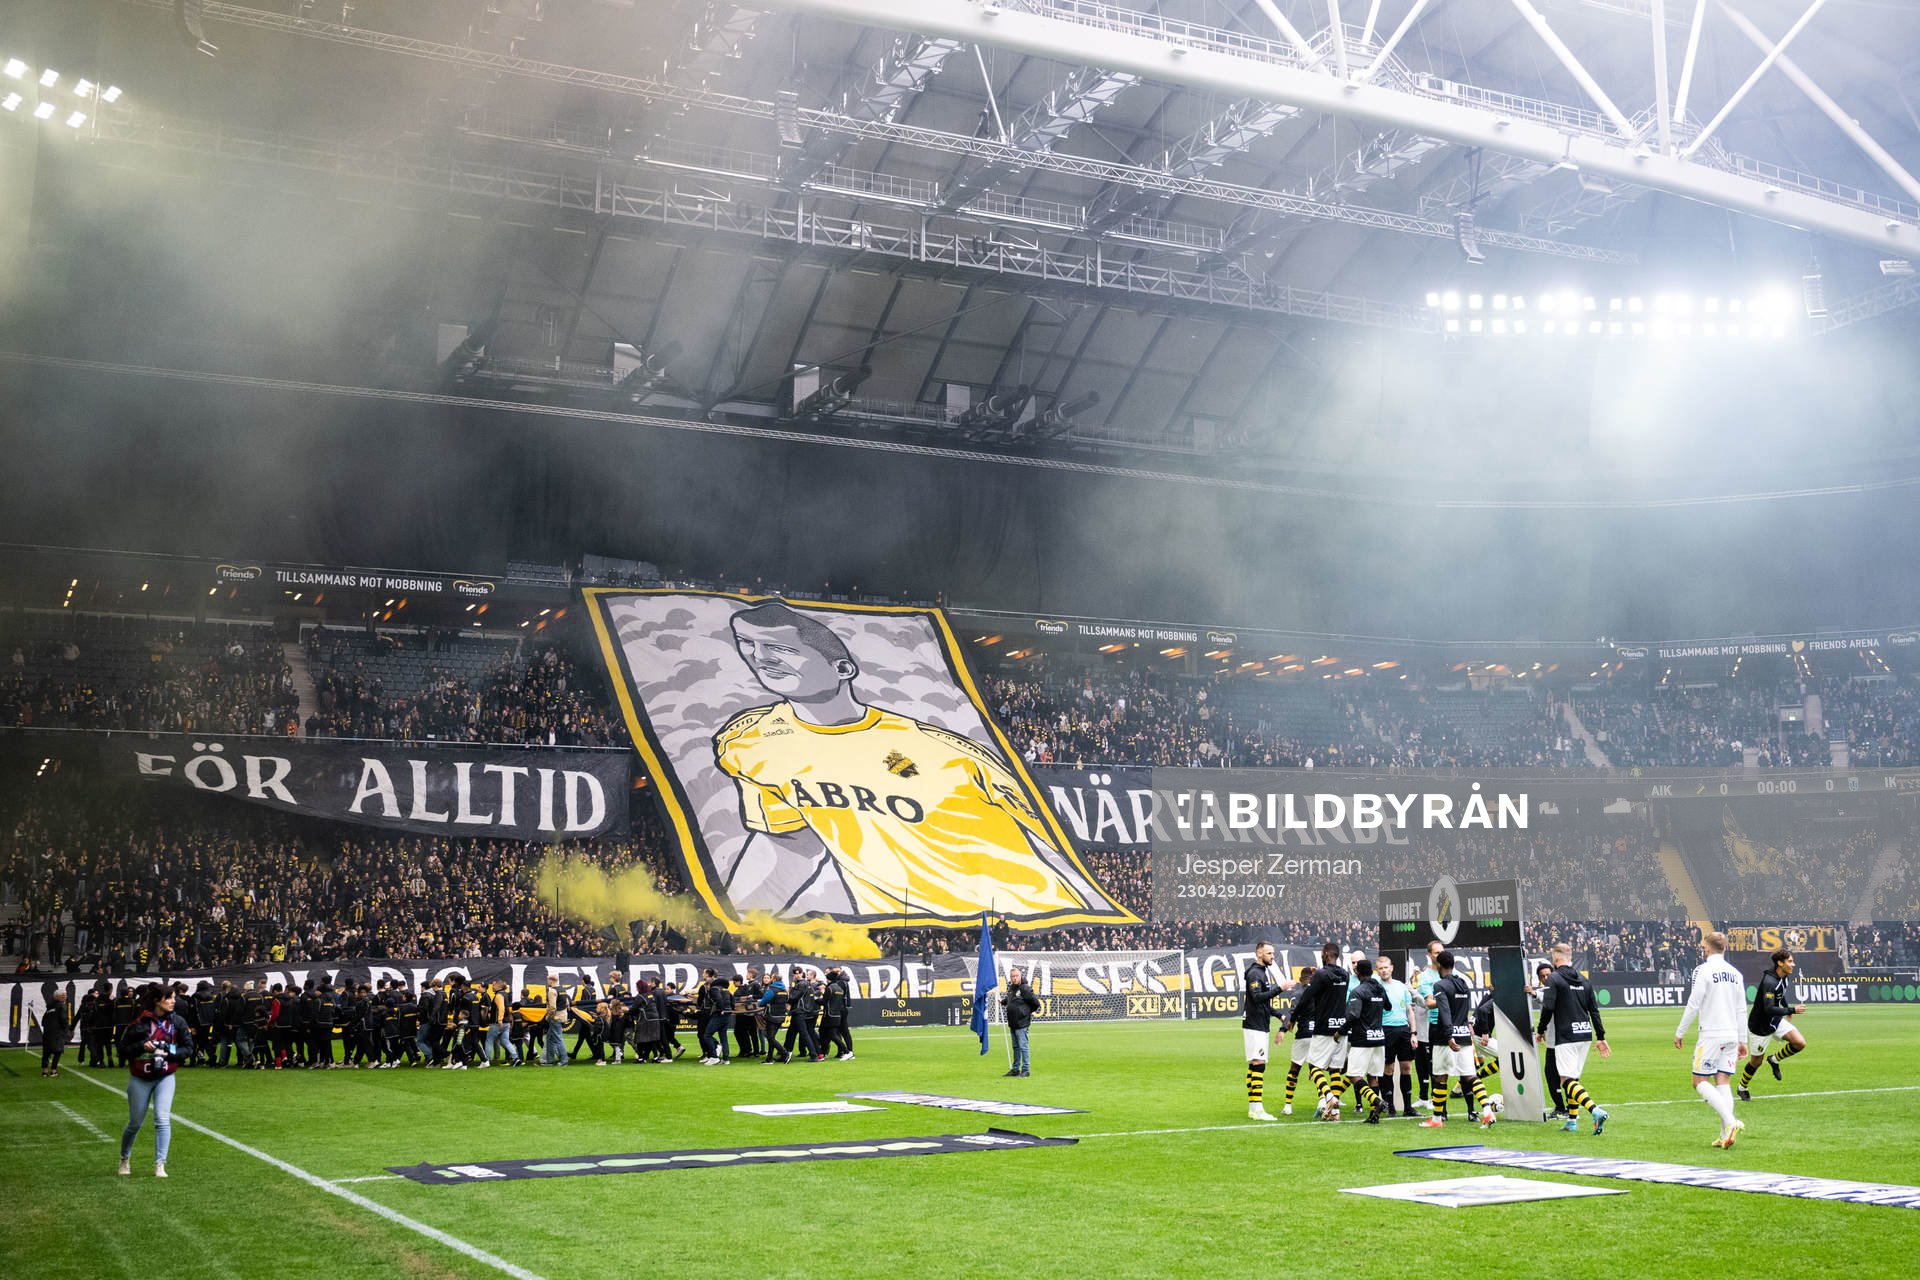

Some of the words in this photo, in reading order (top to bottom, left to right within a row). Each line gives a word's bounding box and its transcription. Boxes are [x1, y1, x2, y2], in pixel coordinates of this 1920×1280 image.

[222, 569, 254, 579] friends
[276, 571, 356, 587] TILLSAMMANS
[360, 577, 382, 588] MOT
[386, 579, 442, 592] MOBBNING
[459, 584, 489, 594] friends
[1078, 625, 1136, 638] TILLSAMMANS
[1138, 629, 1154, 639] MOT
[1156, 630, 1198, 642] MOBBNING
[1659, 647, 1719, 659] TILLSAMMANS
[1721, 645, 1738, 656] MOT
[1742, 643, 1787, 654] MOBBNING
[1809, 640, 1847, 651] FRIENDS
[1849, 638, 1879, 649] ARENA
[348, 757, 607, 832] ALLTID
[1651, 784, 1672, 796] AIK
[1719, 783, 1728, 795] 0
[1757, 780, 1797, 794] 00:00
[1825, 779, 1834, 791] 0
[791, 779, 925, 824] ÅBRO
[1385, 902, 1421, 920] UNIBET
[1467, 895, 1510, 915] UNIBET
[1623, 987, 1685, 1005] UNIBET
[1795, 984, 1858, 1002] UNIBET
[1510, 1051, 1525, 1081] U
